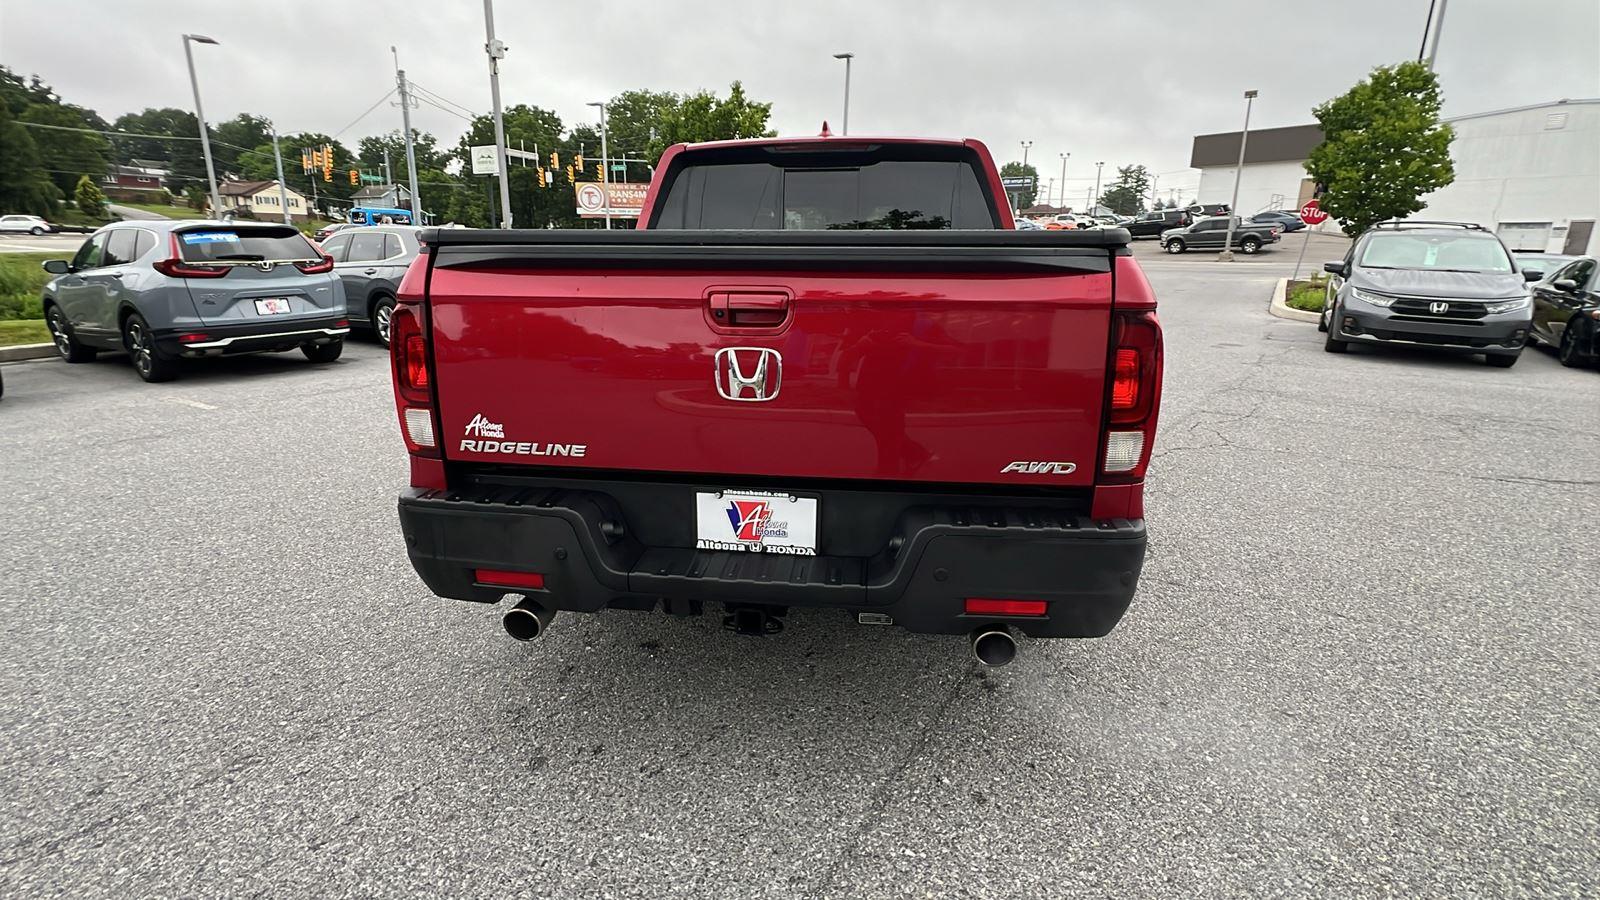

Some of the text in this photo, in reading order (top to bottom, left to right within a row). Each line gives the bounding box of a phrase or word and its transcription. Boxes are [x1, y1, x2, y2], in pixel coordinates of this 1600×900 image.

[481, 429, 504, 438] Honda
[459, 440, 587, 457] RIDGELINE
[1000, 461, 1077, 474] AWD
[723, 489, 789, 498] altoonahonda.com
[757, 528, 787, 537] Honda
[696, 541, 816, 556] Altoona HONDA
